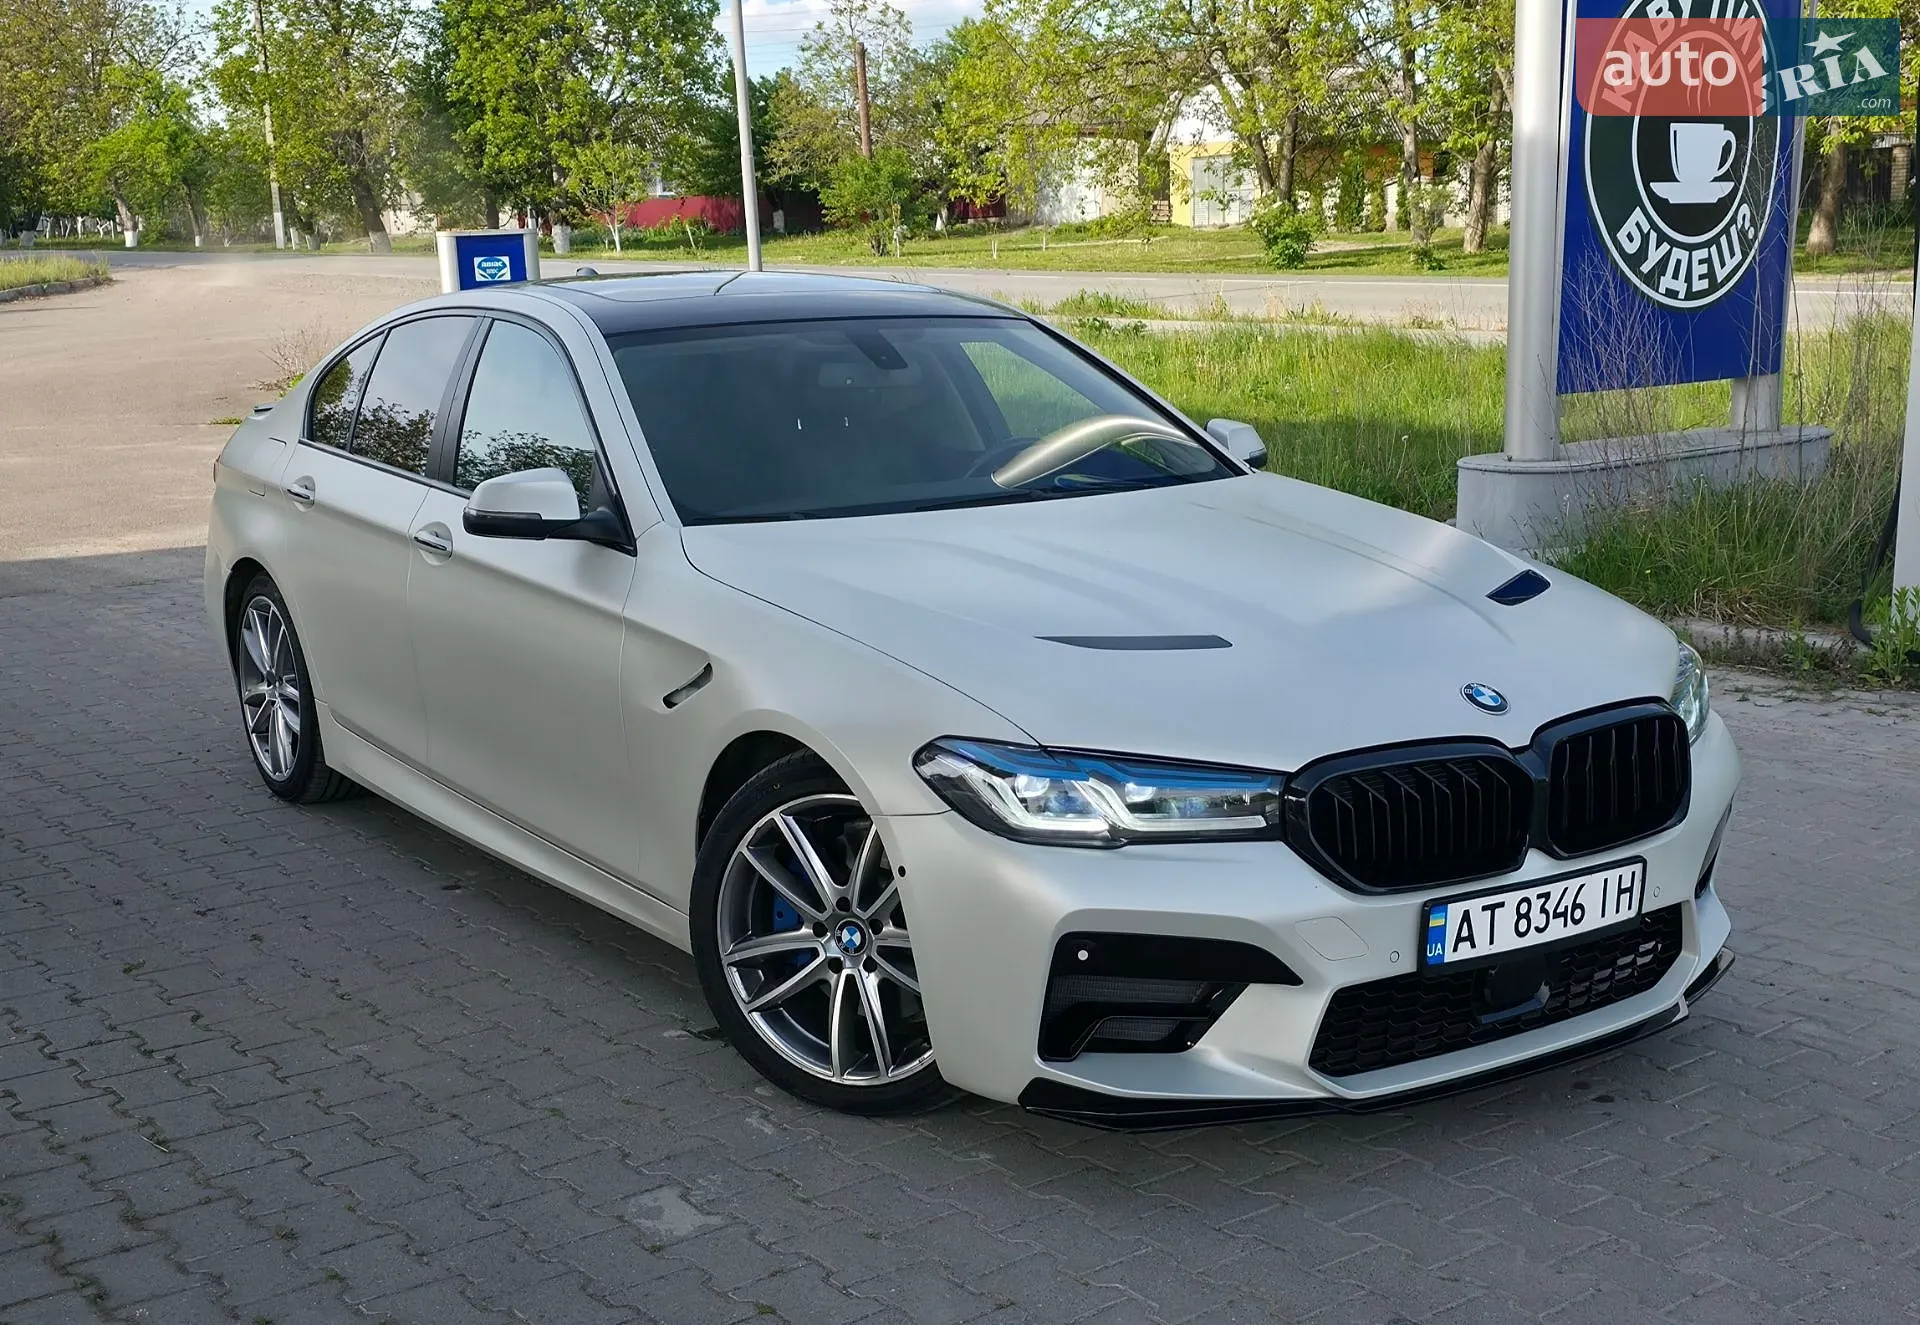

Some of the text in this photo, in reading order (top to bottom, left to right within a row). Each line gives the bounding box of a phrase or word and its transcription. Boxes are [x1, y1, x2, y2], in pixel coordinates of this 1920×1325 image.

[1616, 203, 1756, 299] БУДЕШ?
[1426, 943, 1443, 957] UA
[1452, 870, 1637, 953] AT 8346 IH
